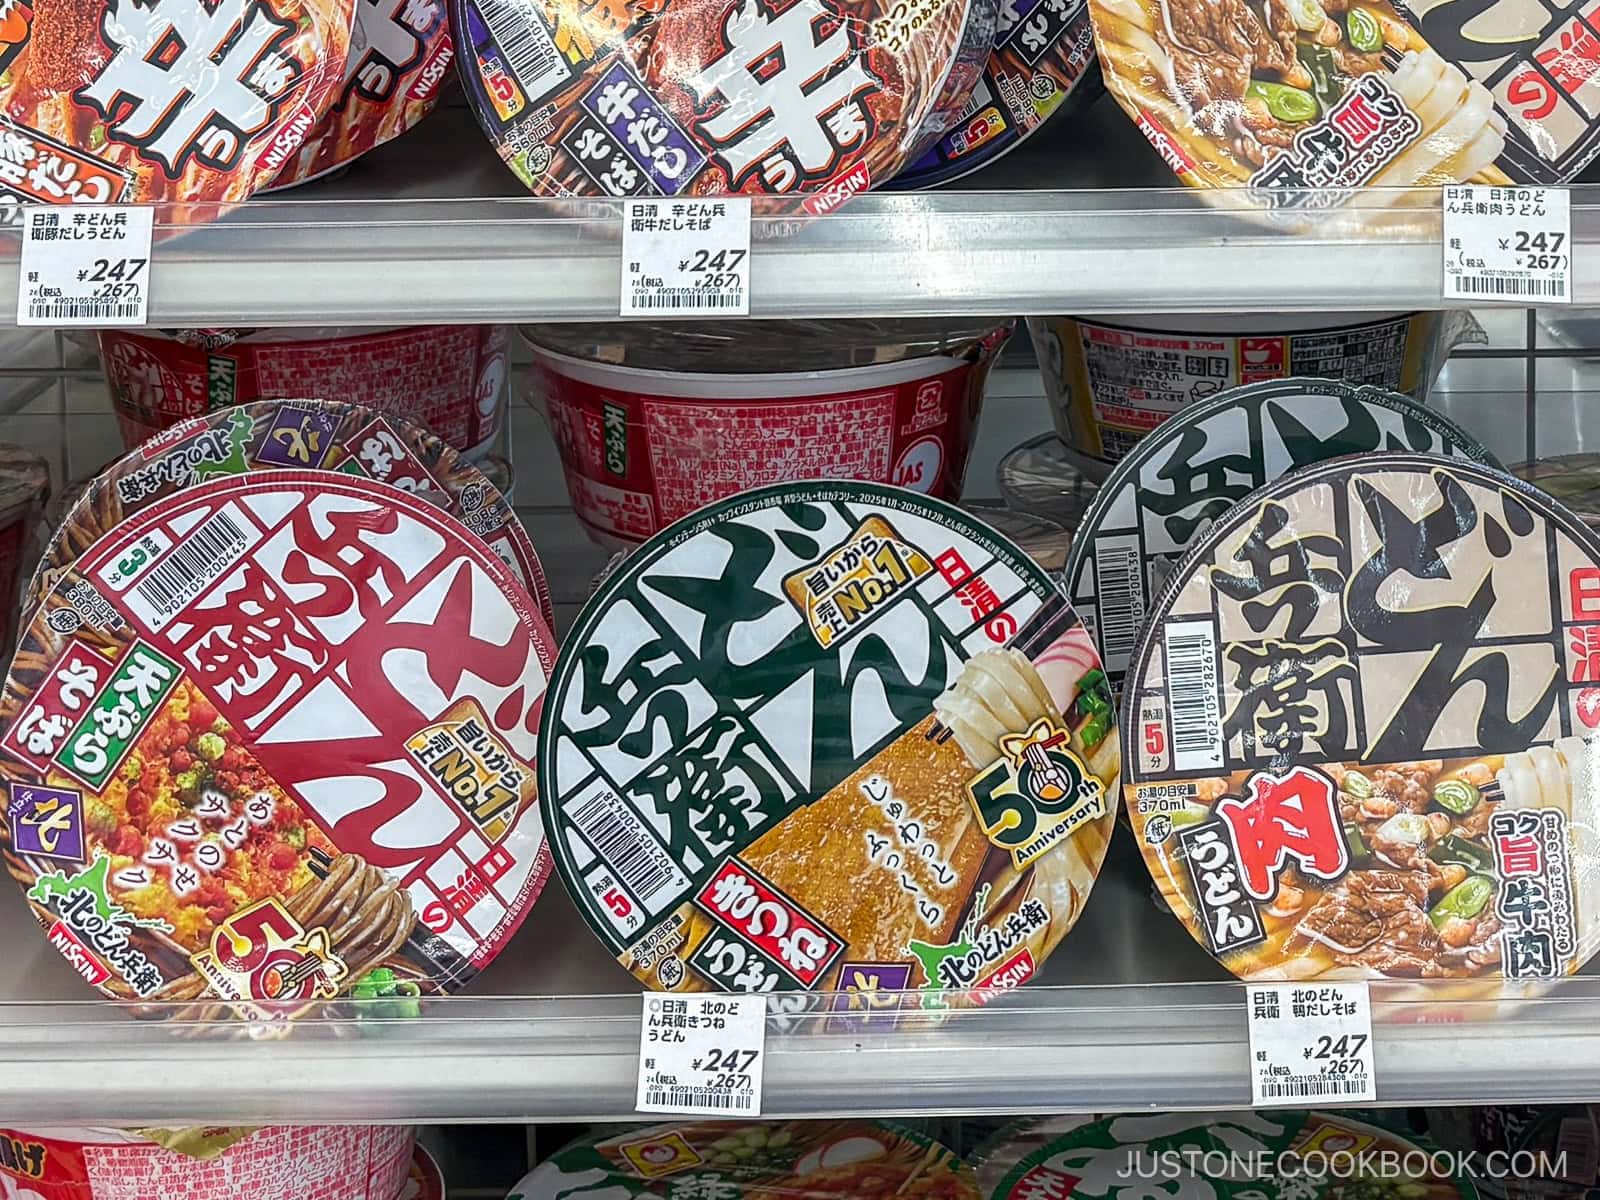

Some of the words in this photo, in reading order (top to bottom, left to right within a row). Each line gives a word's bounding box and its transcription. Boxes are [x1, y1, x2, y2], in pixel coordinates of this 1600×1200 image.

[415, 45, 454, 98] NISSIN
[265, 113, 314, 169] NISSIN
[72, 647, 176, 778] 天ぷら
[1016, 796, 1103, 865] Anniversary
[51, 932, 99, 987] NISSIN
[648, 1029, 686, 1043] うどん
